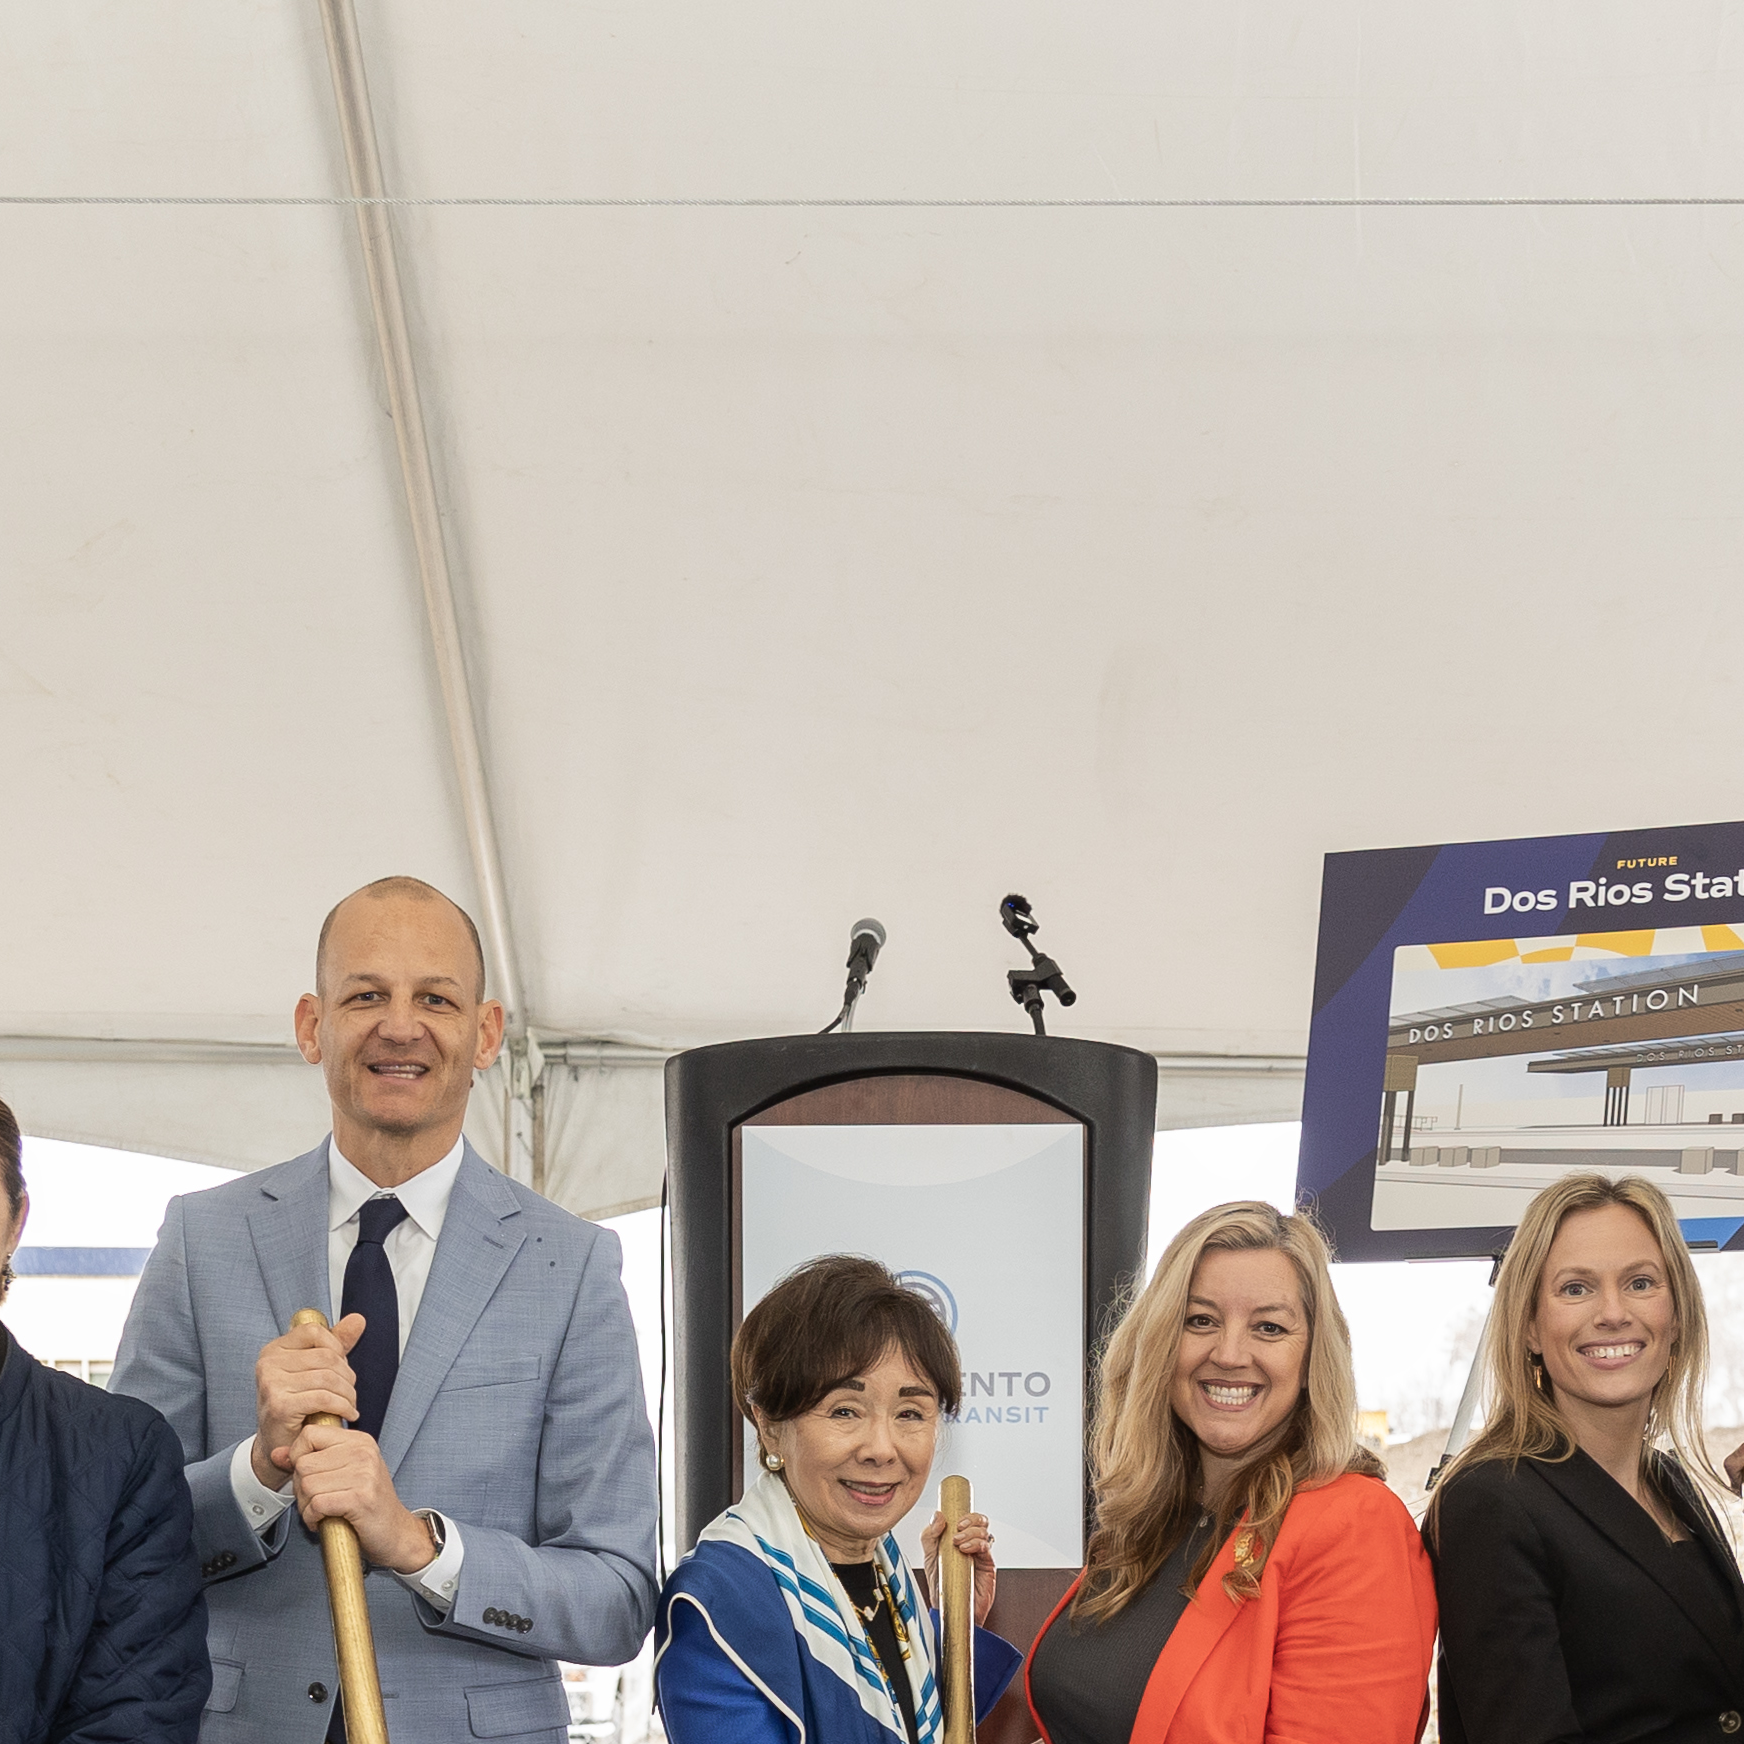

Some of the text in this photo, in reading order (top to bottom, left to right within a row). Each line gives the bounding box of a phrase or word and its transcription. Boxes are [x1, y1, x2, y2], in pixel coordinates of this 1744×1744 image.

[1616, 856, 1678, 870] FUTURE
[1483, 886, 1558, 915] Dos
[1568, 876, 1654, 909] Rios
[1409, 984, 1699, 1044] DOS RIOS STATION
[1636, 1051, 1666, 1063] DOS
